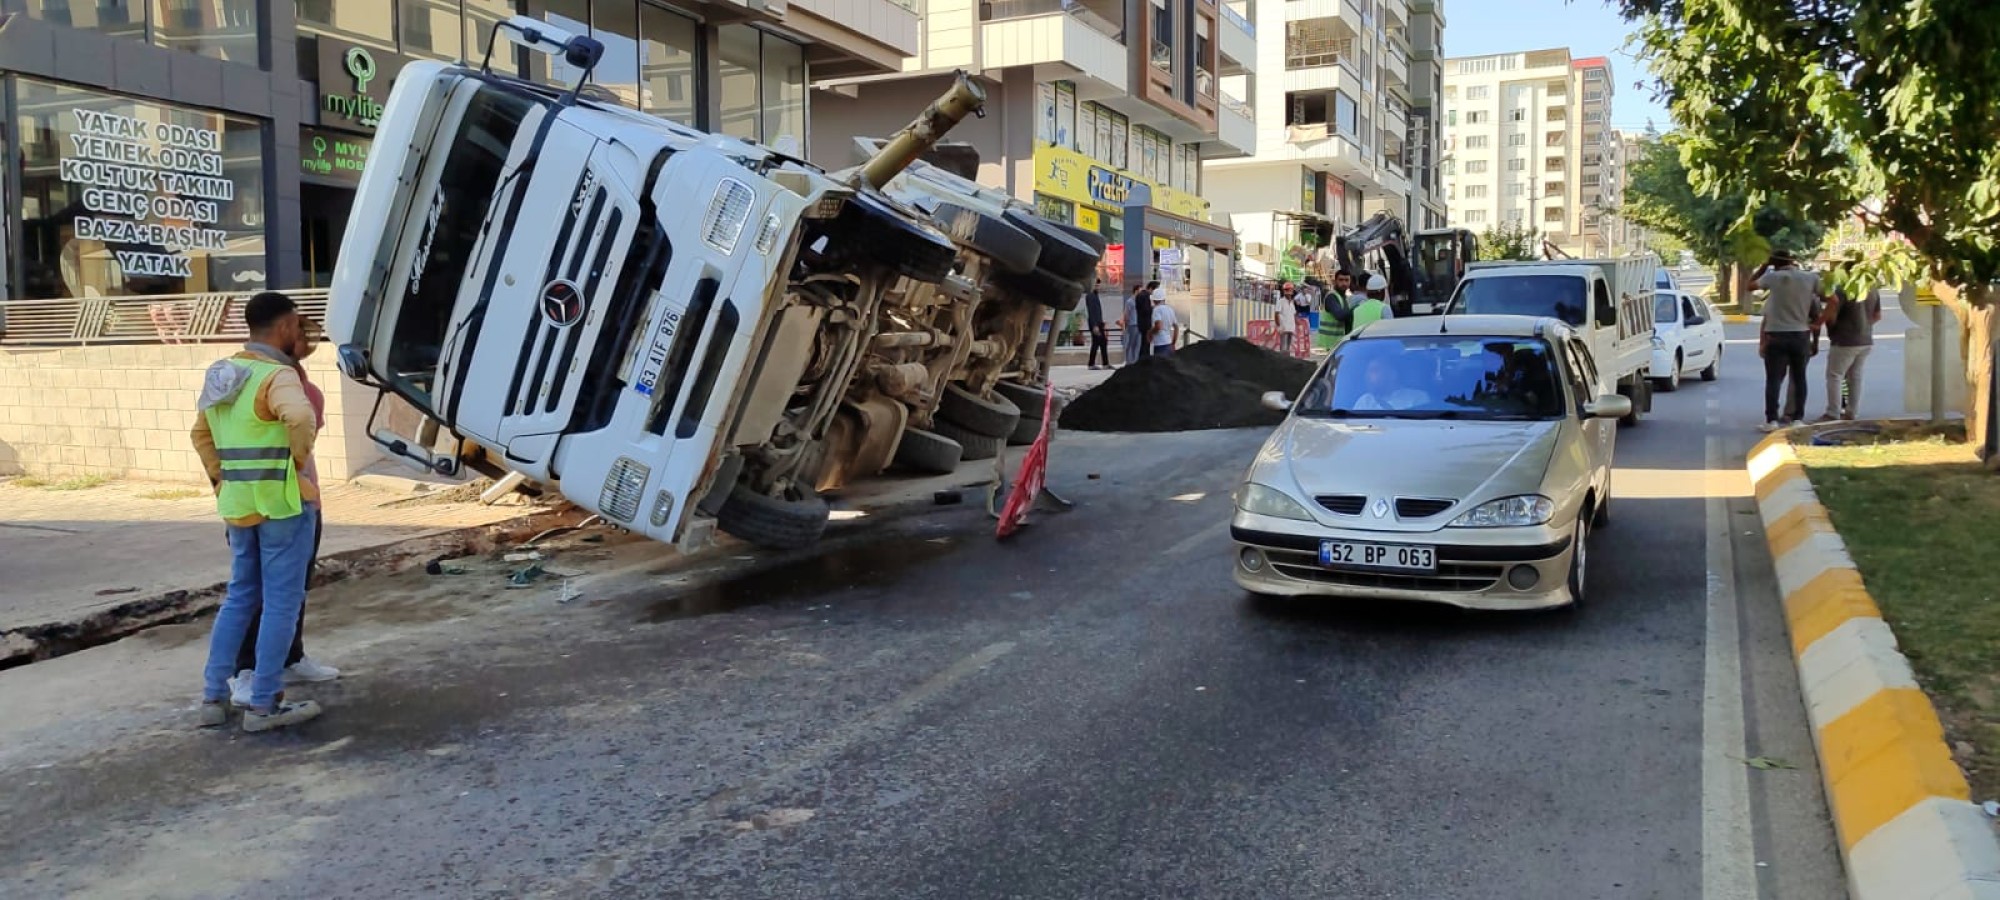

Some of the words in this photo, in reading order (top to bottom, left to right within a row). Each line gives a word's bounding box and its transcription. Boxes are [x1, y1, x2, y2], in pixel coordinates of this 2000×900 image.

[327, 93, 383, 120] mylife
[73, 108, 149, 139] YATAK
[154, 124, 221, 151] ODASI
[70, 134, 156, 166] YEMEK
[158, 149, 222, 176] ODASI
[335, 141, 369, 158] MYL
[335, 157, 365, 171] MOB
[60, 159, 157, 191] KOLTUK
[159, 171, 234, 200] TAKIMI
[83, 189, 149, 221] GENÇ
[152, 197, 218, 223] ODASI
[74, 216, 227, 250] BAZA+BAŞLIK
[116, 250, 192, 276] YATAK
[640, 369, 657, 387] 63
[660, 311, 679, 337] 876
[1332, 544, 1353, 562] 52
[1364, 546, 1386, 564] BP
[1398, 548, 1432, 567] 063
